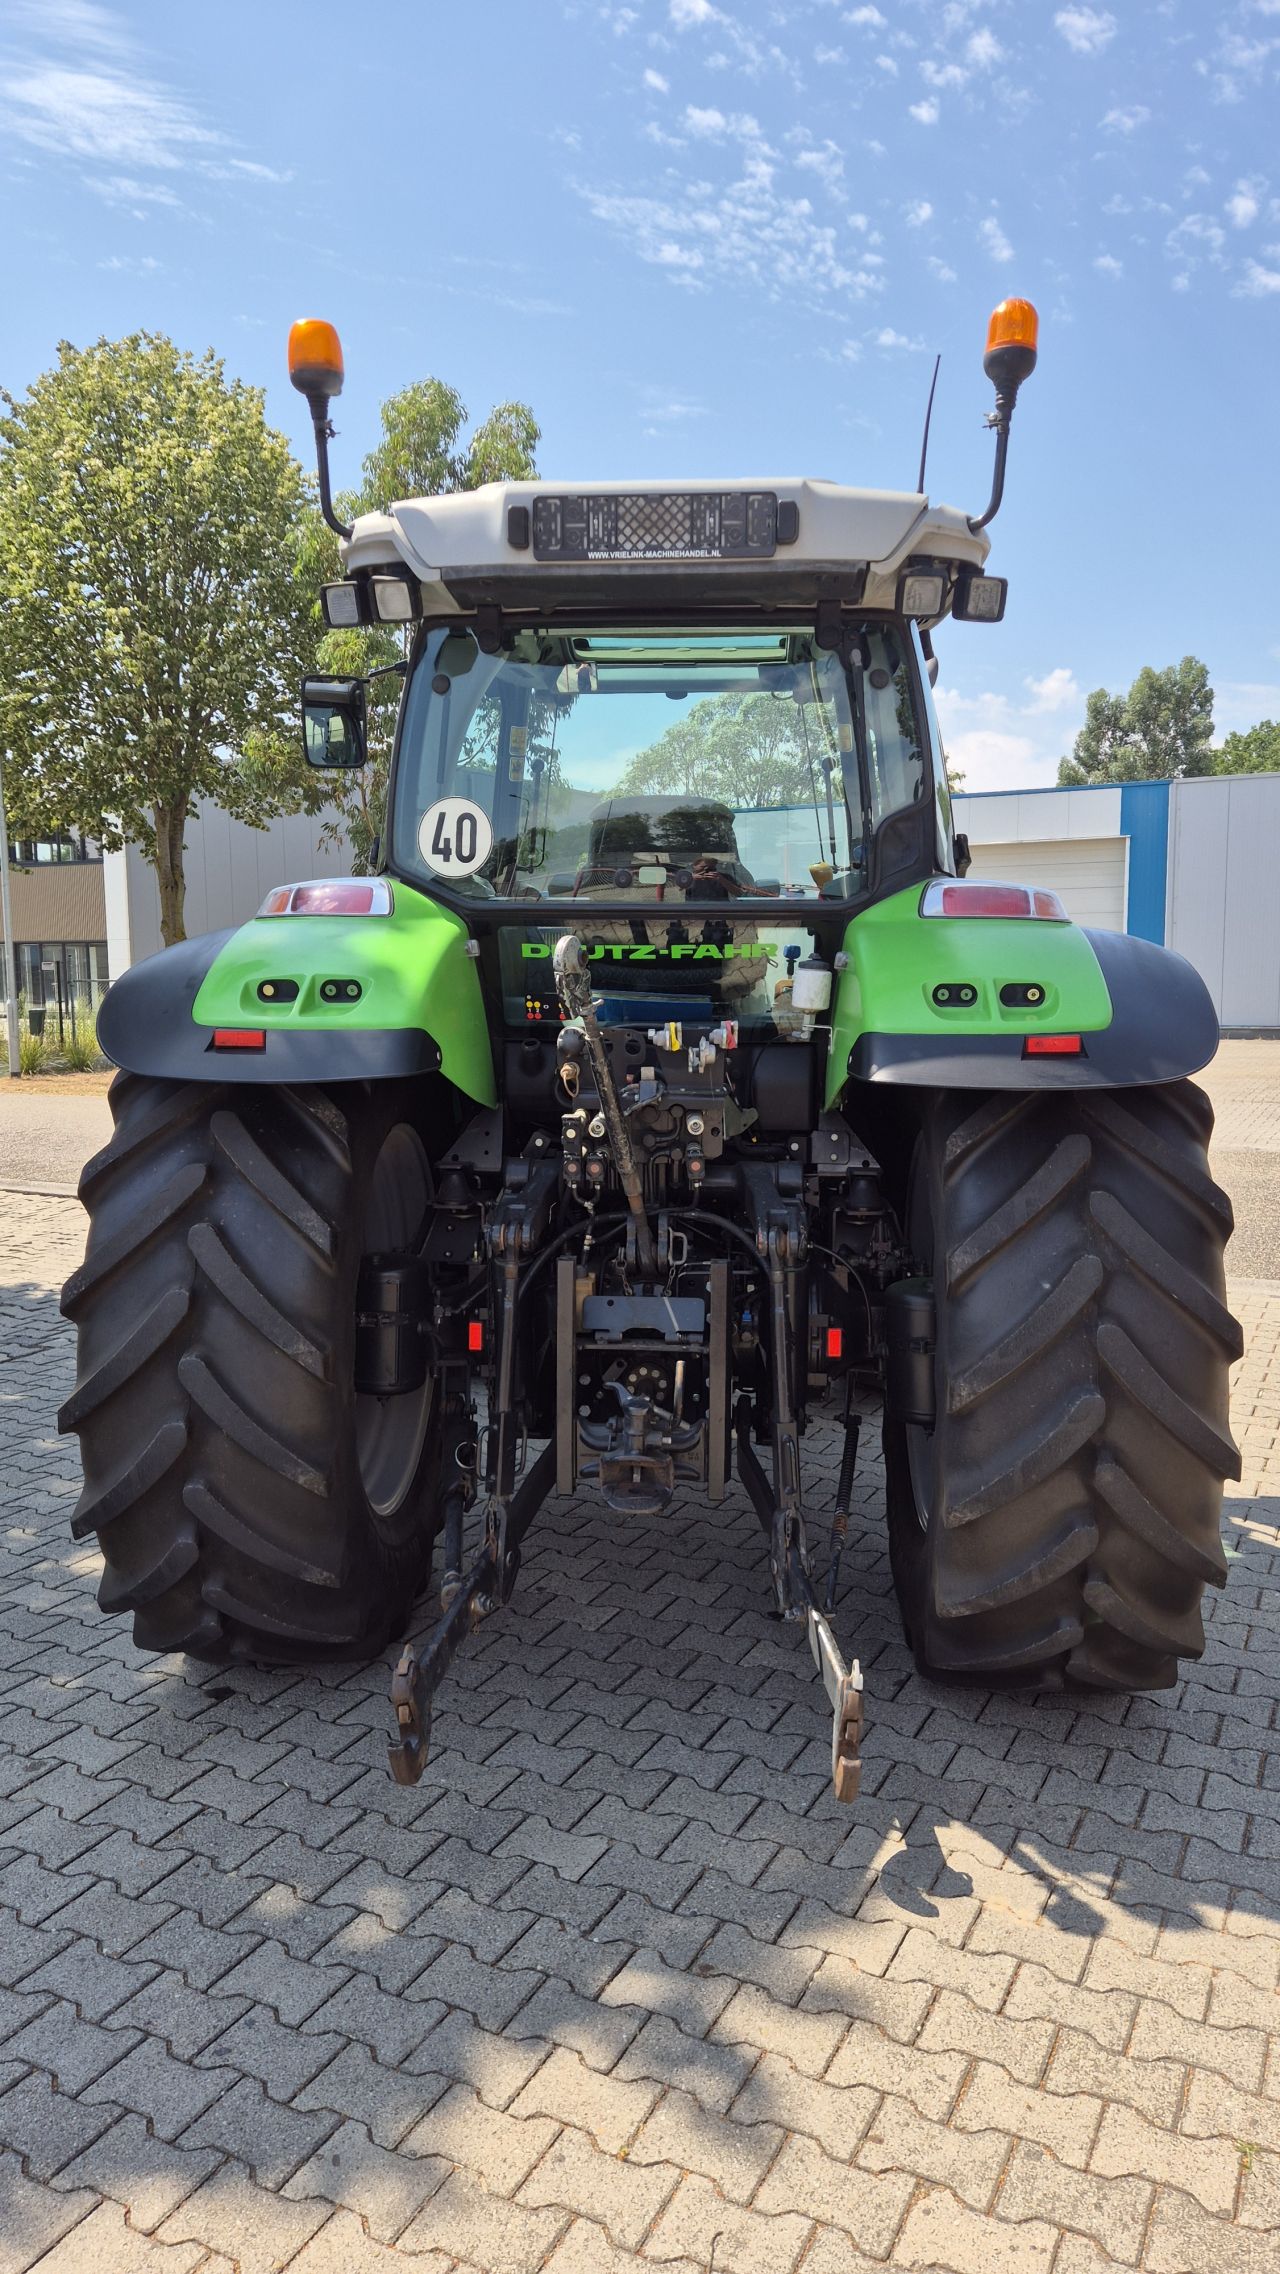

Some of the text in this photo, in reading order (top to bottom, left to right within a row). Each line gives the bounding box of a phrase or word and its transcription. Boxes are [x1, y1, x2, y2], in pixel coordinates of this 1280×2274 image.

[587, 549, 722, 559] WWW.VRIELINK-MACHINEHANDEL.NL
[431, 811, 477, 863] 40
[521, 943, 778, 960] DUTZ-FAHR
